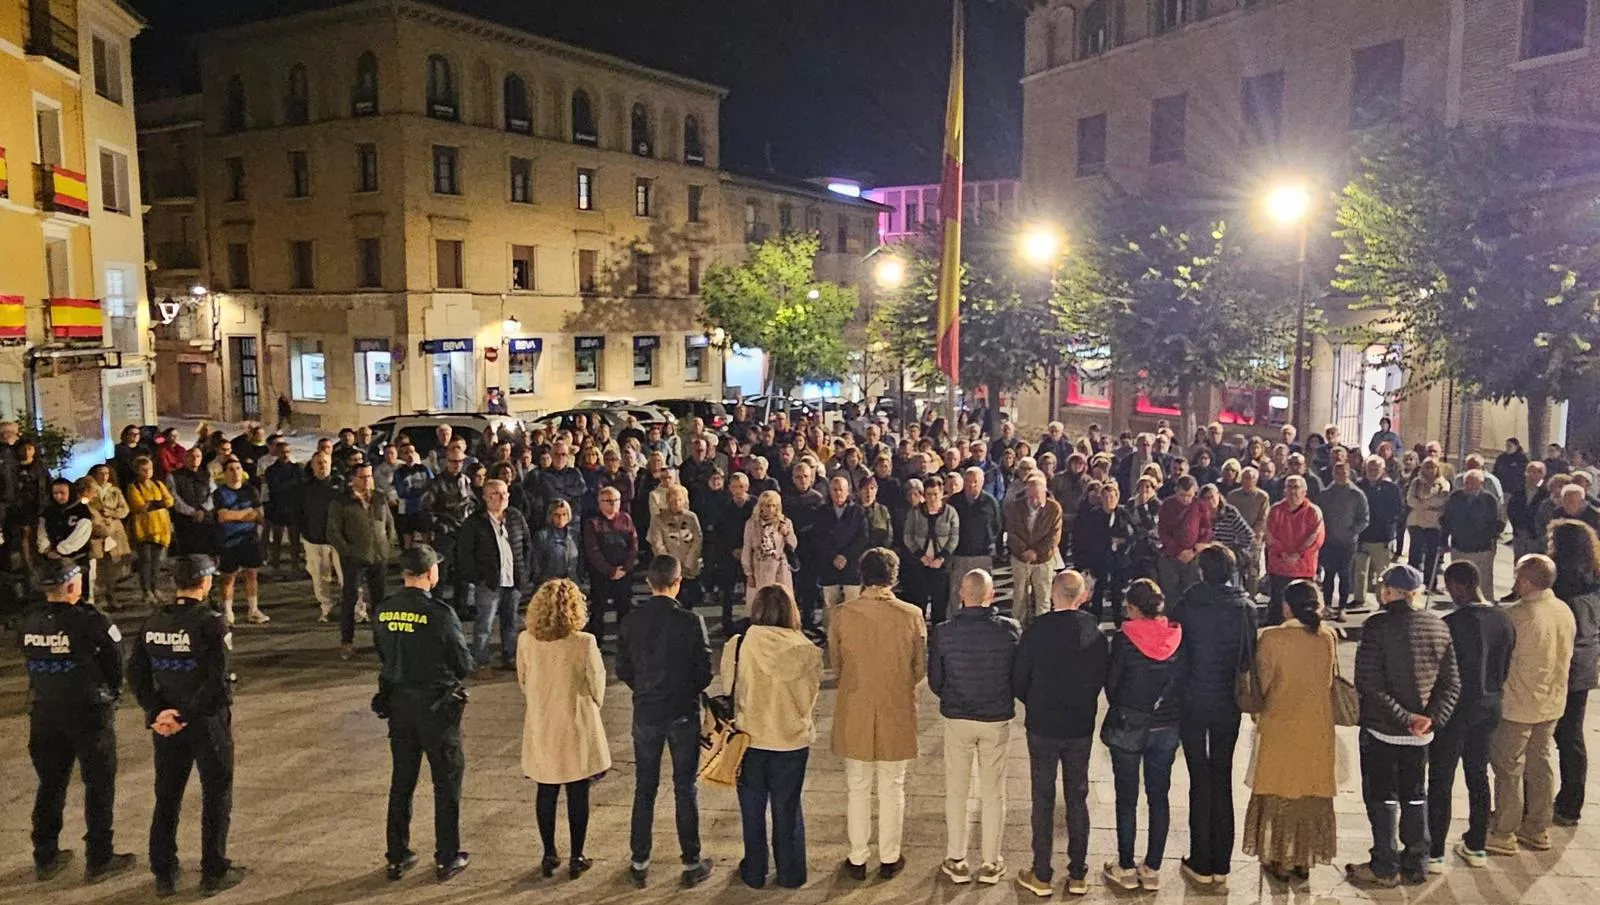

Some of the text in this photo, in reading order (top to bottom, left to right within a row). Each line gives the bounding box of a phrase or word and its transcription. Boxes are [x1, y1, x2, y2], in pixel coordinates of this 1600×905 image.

[442, 341, 466, 351] BBVA
[514, 340, 536, 350] BBVA
[379, 611, 428, 624] GUARDIA
[388, 621, 415, 632] CIVIL
[24, 630, 70, 647] POLICÍA
[145, 629, 191, 646] POLICÍA
